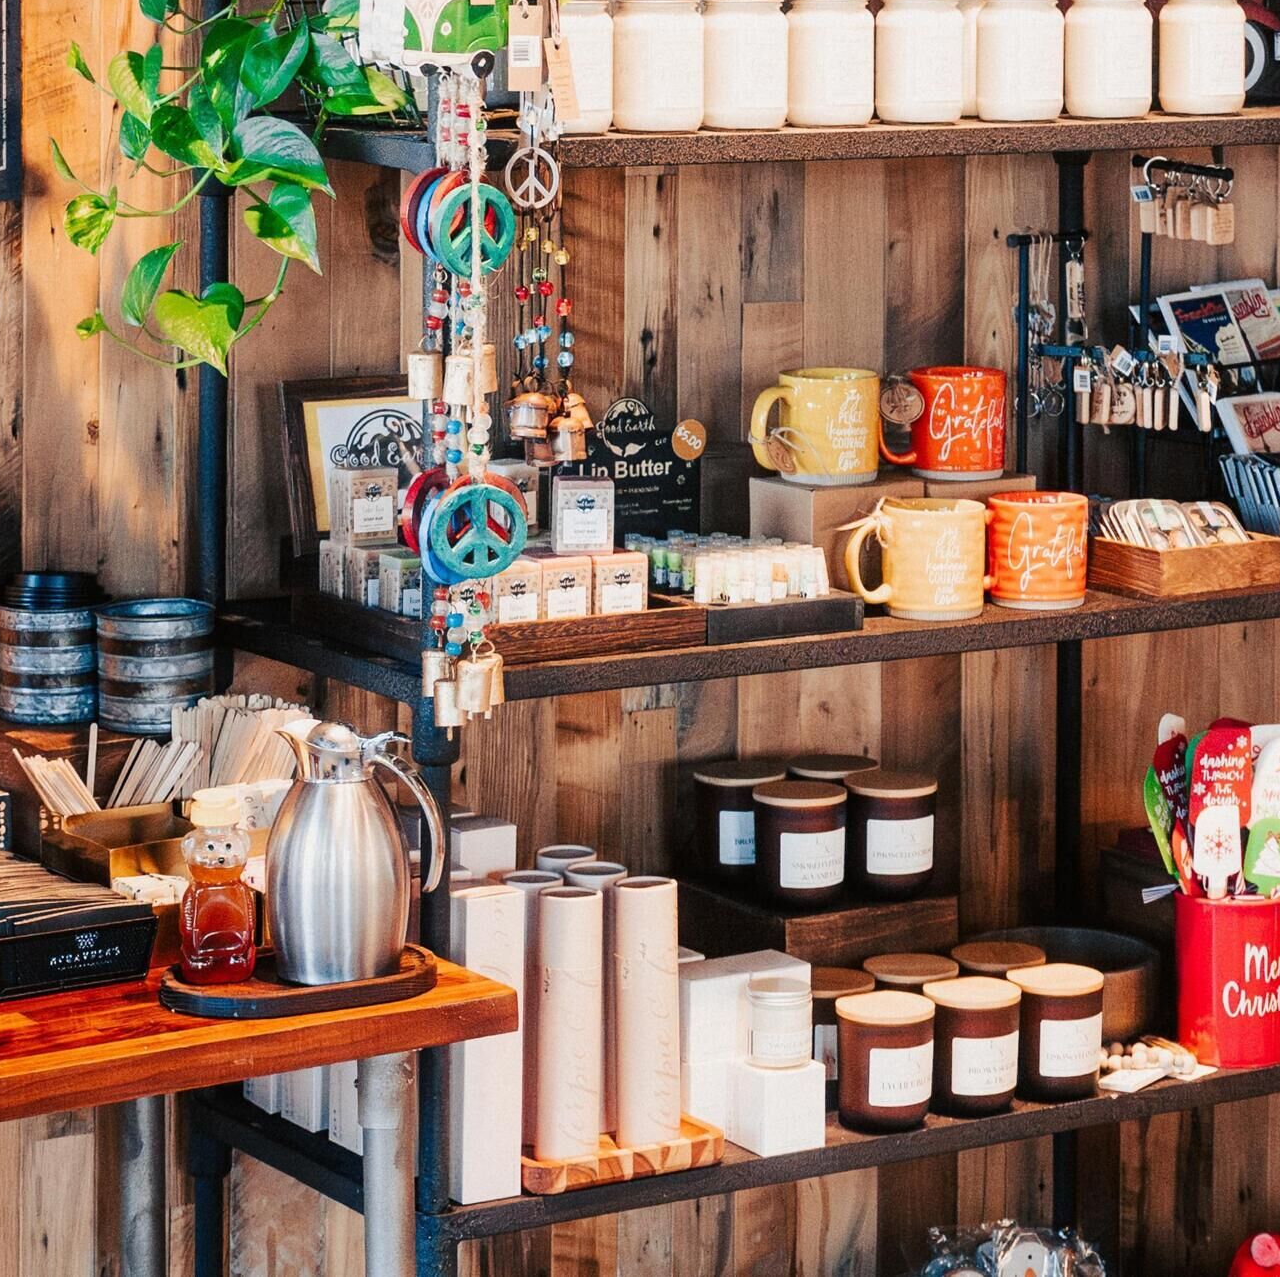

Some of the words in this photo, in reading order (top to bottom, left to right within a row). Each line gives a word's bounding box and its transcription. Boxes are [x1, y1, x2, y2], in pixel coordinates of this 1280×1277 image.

[595, 419, 623, 439] Good
[624, 415, 657, 433] Earth
[929, 382, 1007, 462] Grateful
[675, 424, 703, 451] $5.00
[330, 441, 383, 468] Good
[387, 441, 424, 464] Ear
[614, 458, 673, 479] Butter
[1007, 511, 1087, 592] Grateful
[1199, 753, 1247, 768] dashing
[1201, 769, 1245, 782] THROUGH
[1202, 789, 1241, 806] dough
[1213, 783, 1233, 794] THE
